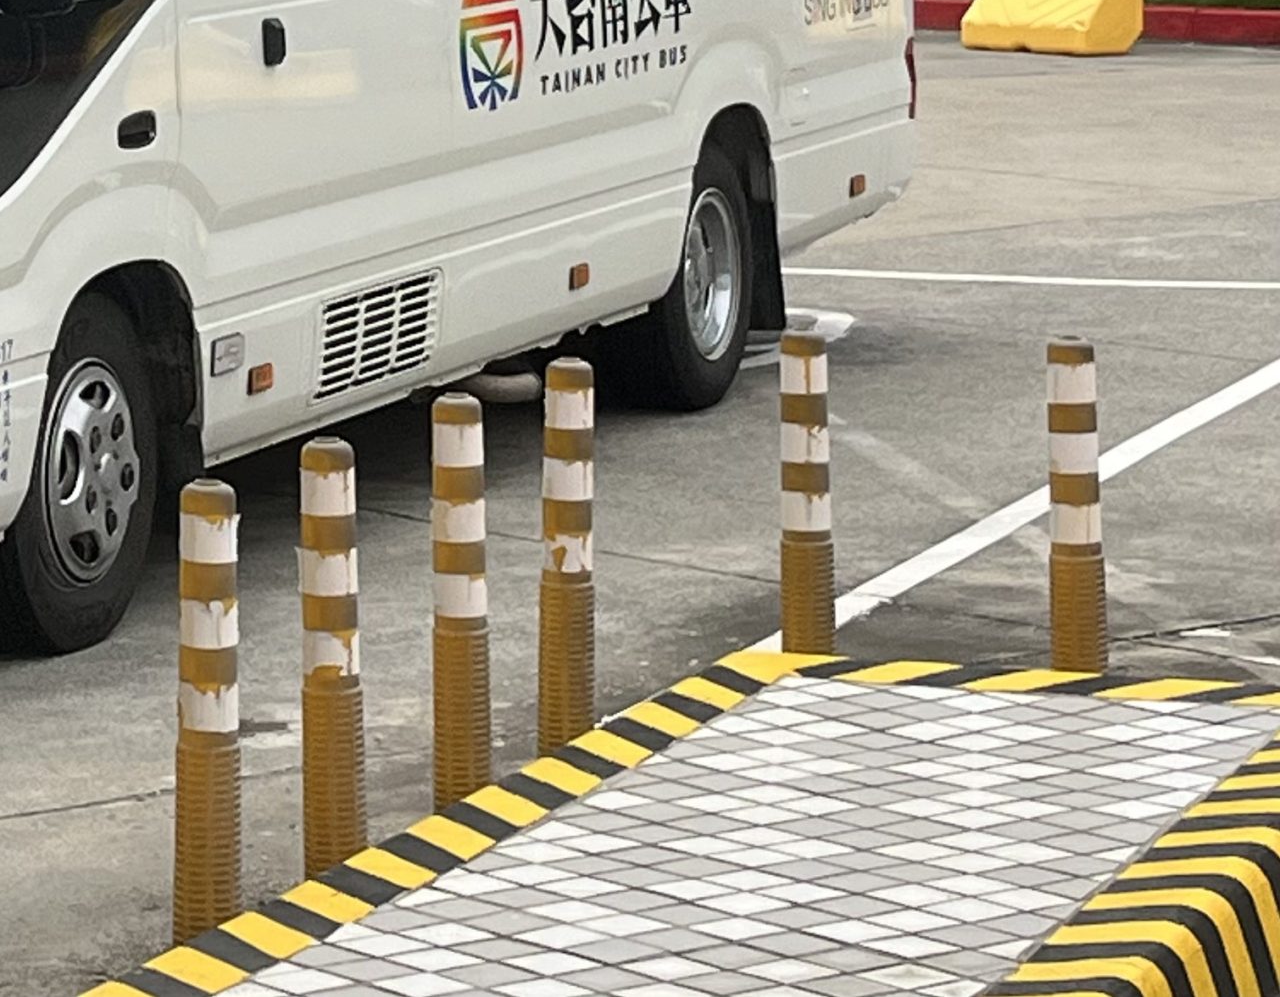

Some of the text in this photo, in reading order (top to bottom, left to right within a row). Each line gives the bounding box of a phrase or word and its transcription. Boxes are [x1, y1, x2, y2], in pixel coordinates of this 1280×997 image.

[540, 45, 688, 96] TAINAN CITY BUS
